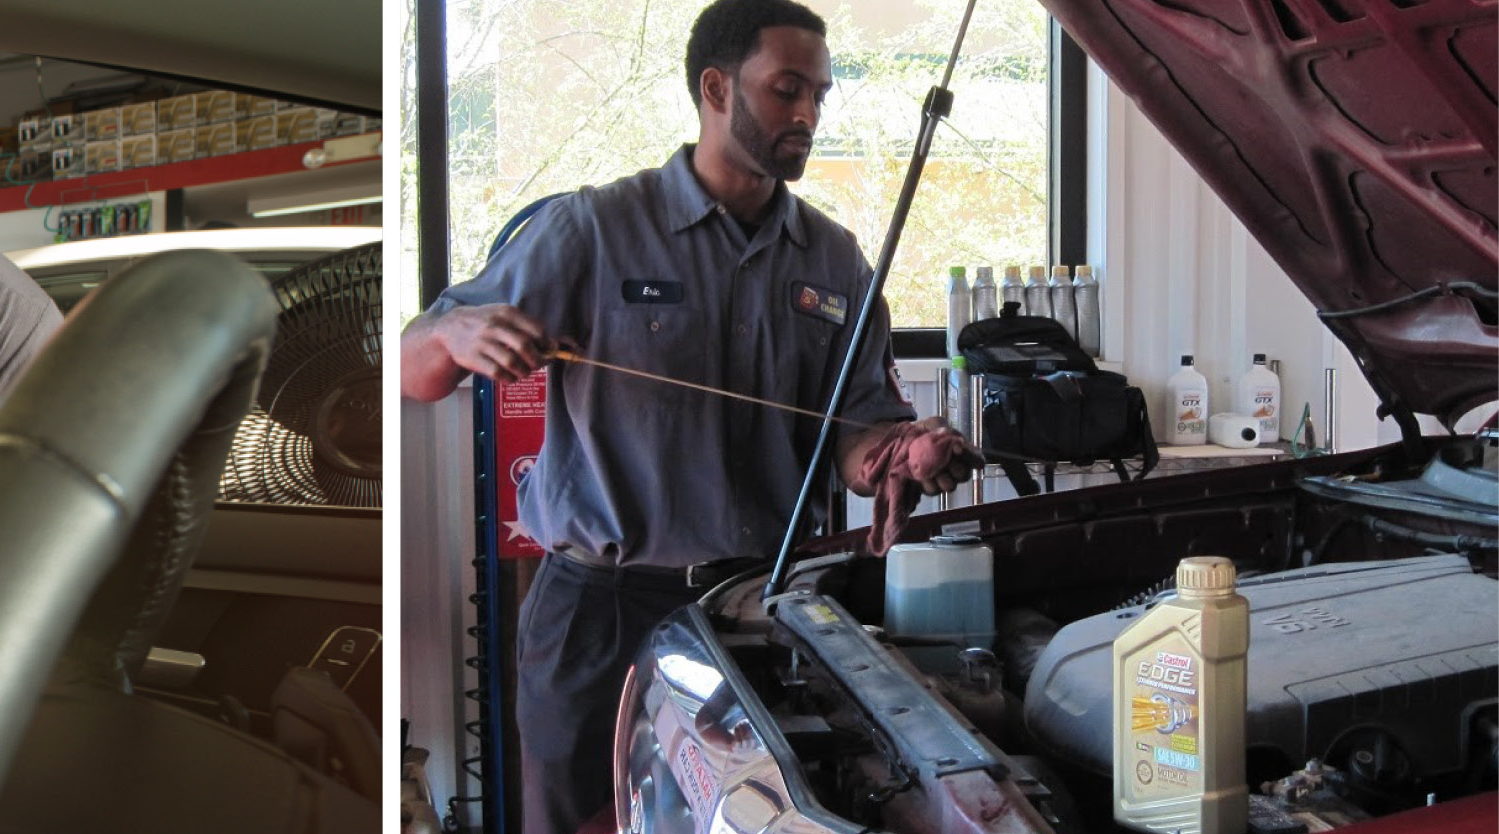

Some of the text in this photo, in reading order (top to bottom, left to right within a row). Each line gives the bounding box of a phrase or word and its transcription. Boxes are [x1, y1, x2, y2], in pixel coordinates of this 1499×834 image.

[332, 205, 363, 227] EXIT
[828, 296, 838, 307] OIL
[1182, 399, 1201, 407] GTX
[1255, 396, 1273, 404] GTX
[1163, 654, 1188, 668] Castrol
[1137, 661, 1195, 687] EDGE
[1169, 751, 1195, 769] 5W-30
